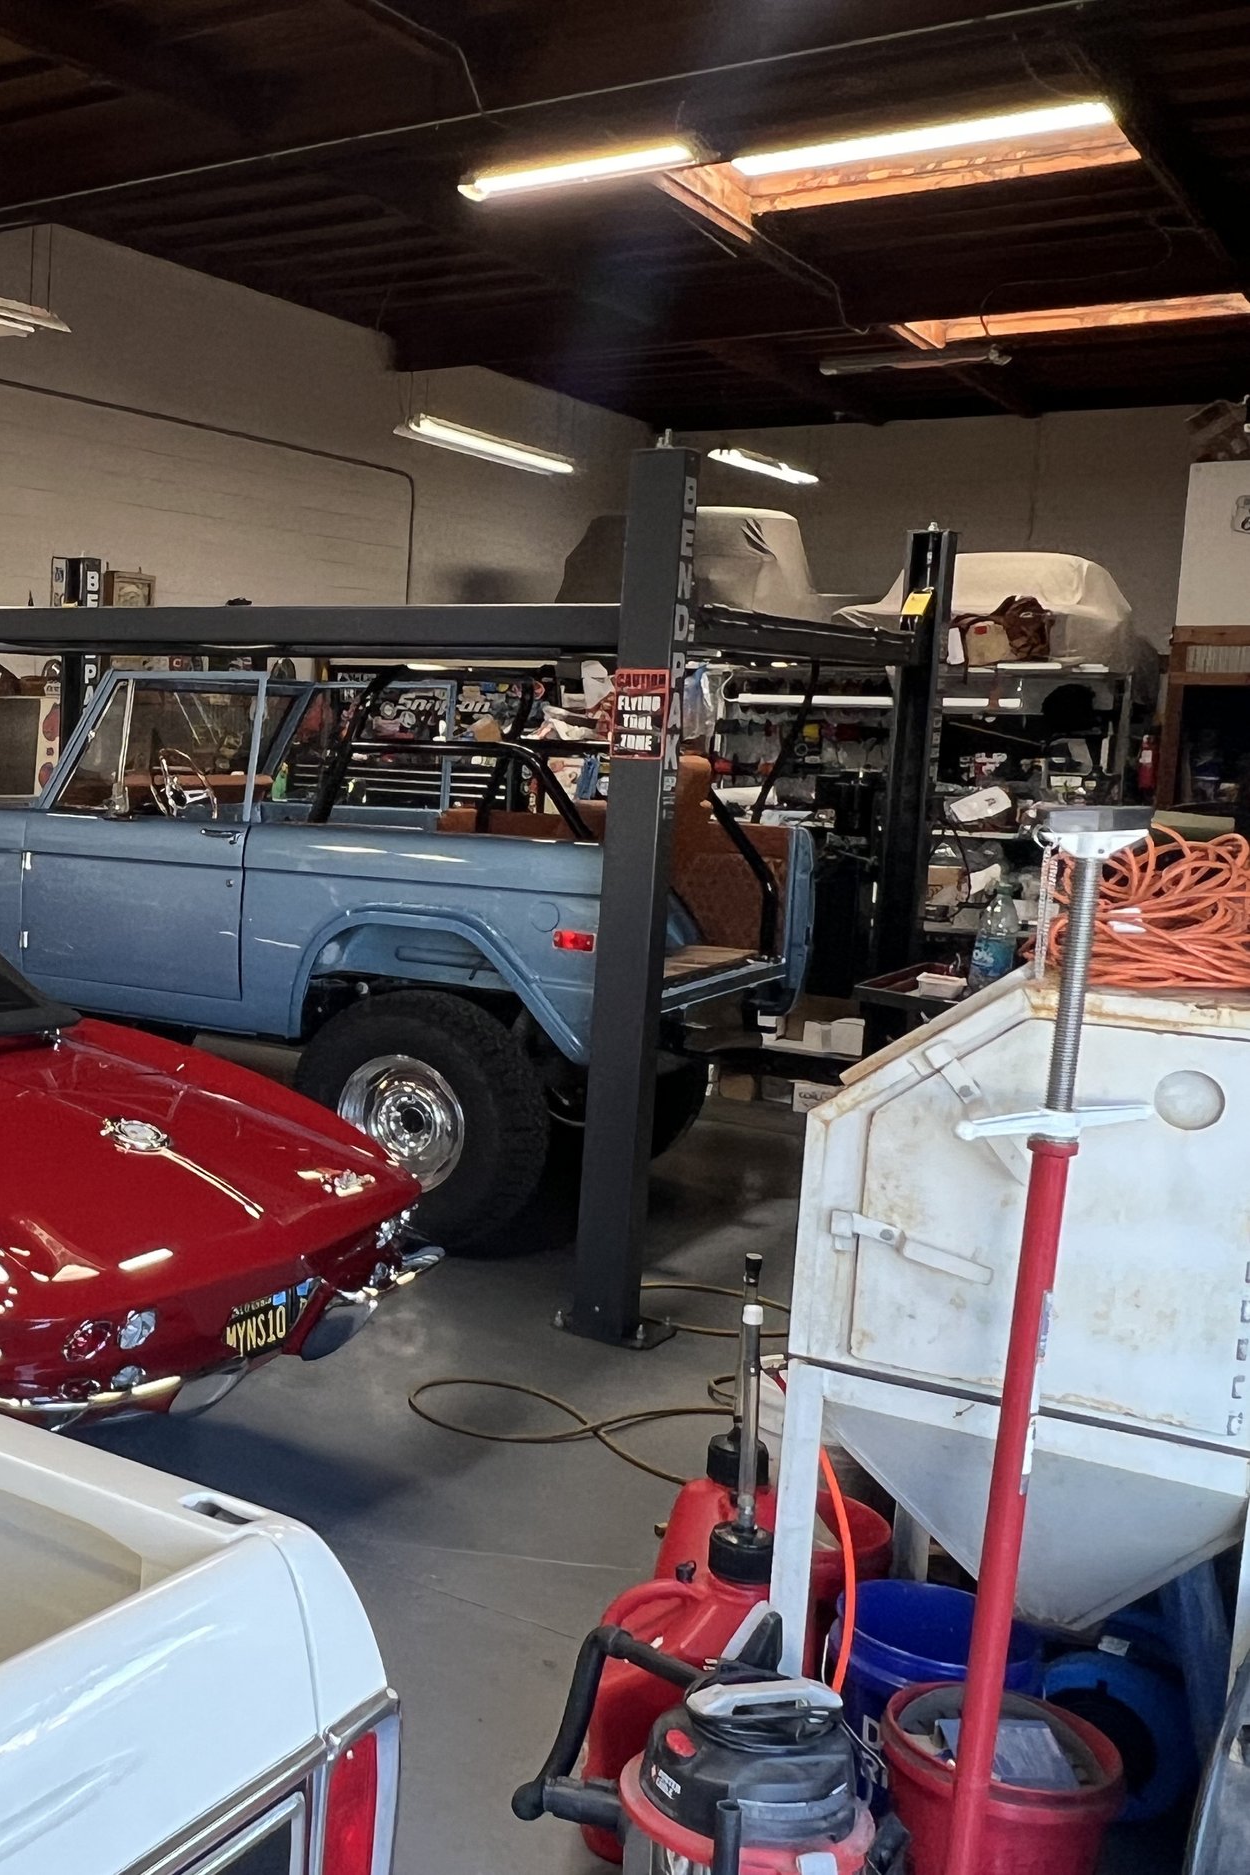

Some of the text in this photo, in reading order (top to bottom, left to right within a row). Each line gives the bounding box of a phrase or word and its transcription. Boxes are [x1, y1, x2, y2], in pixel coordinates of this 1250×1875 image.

[664, 476, 698, 770] BENDPAK
[616, 672, 666, 688] CAUTION
[620, 734, 653, 751] ZONE
